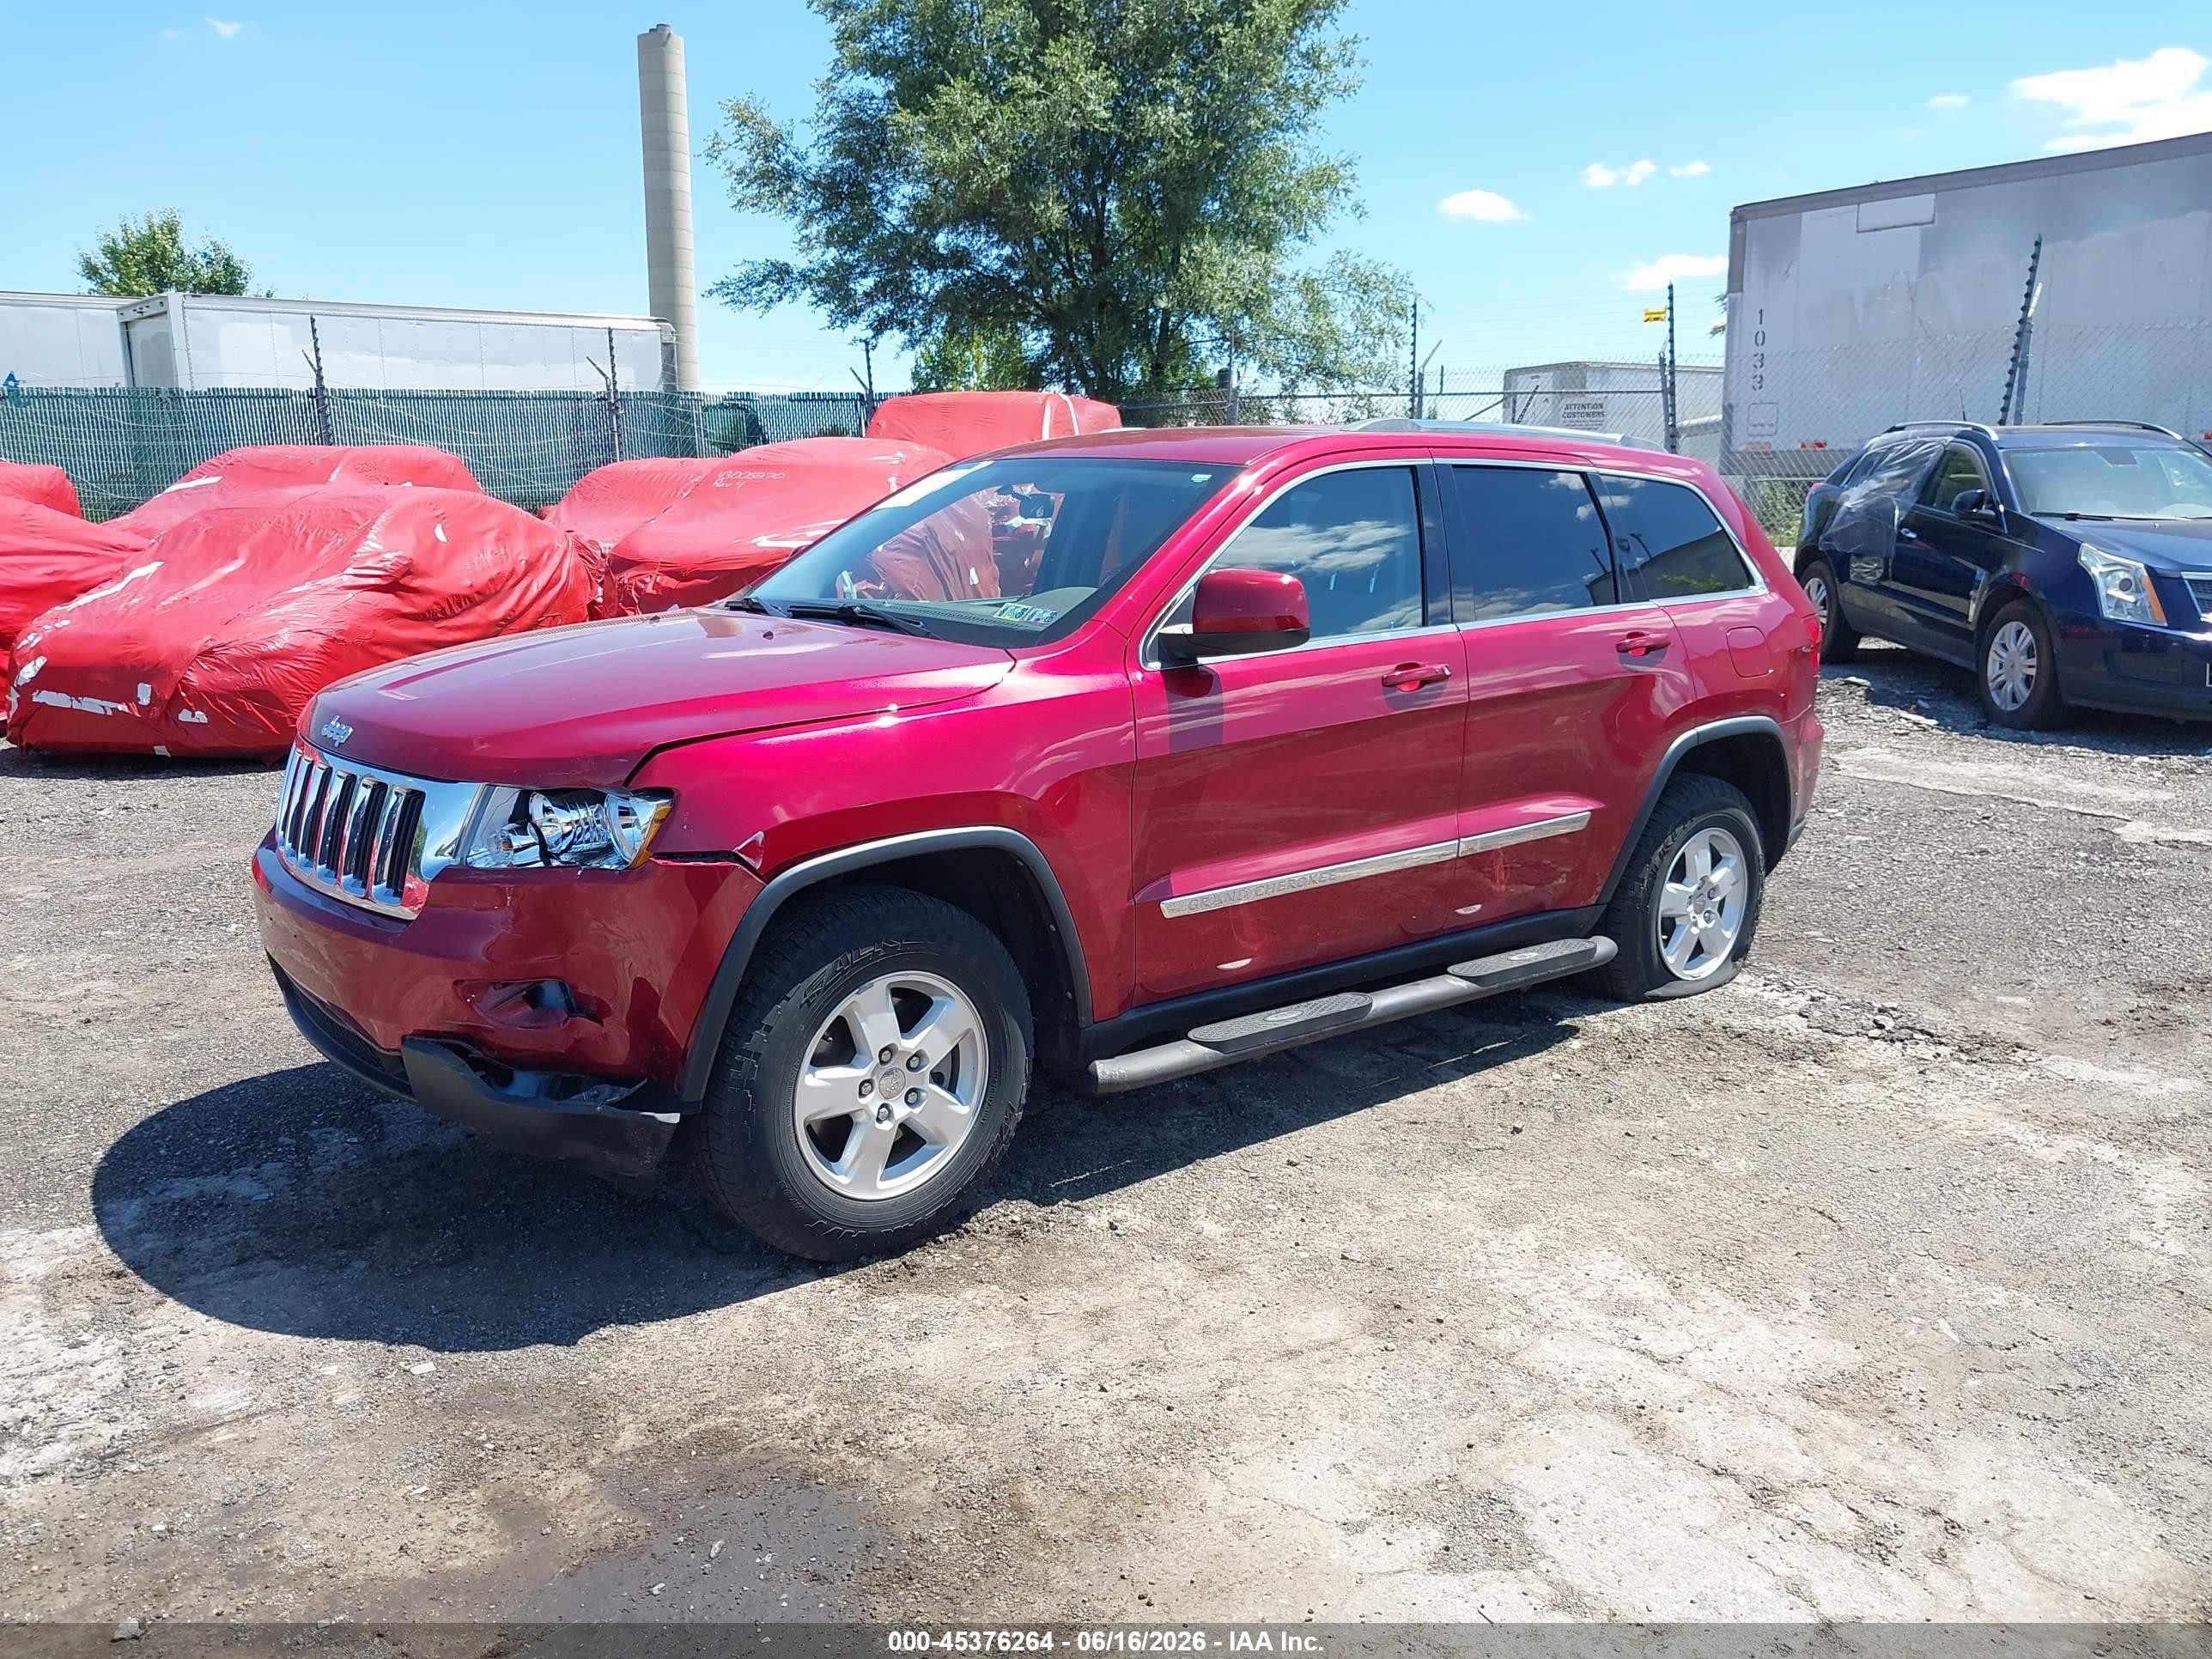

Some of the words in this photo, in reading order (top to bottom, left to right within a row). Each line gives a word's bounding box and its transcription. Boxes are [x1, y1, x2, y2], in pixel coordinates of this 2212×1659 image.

[1751, 307, 1766, 392] 1033
[1561, 410, 1606, 419] CUSTOMERS
[1564, 402, 1604, 410] ATTENTION
[321, 714, 354, 748] Jeep
[1187, 888, 1249, 912] GRAND
[1254, 871, 1340, 896] CHEROKEE
